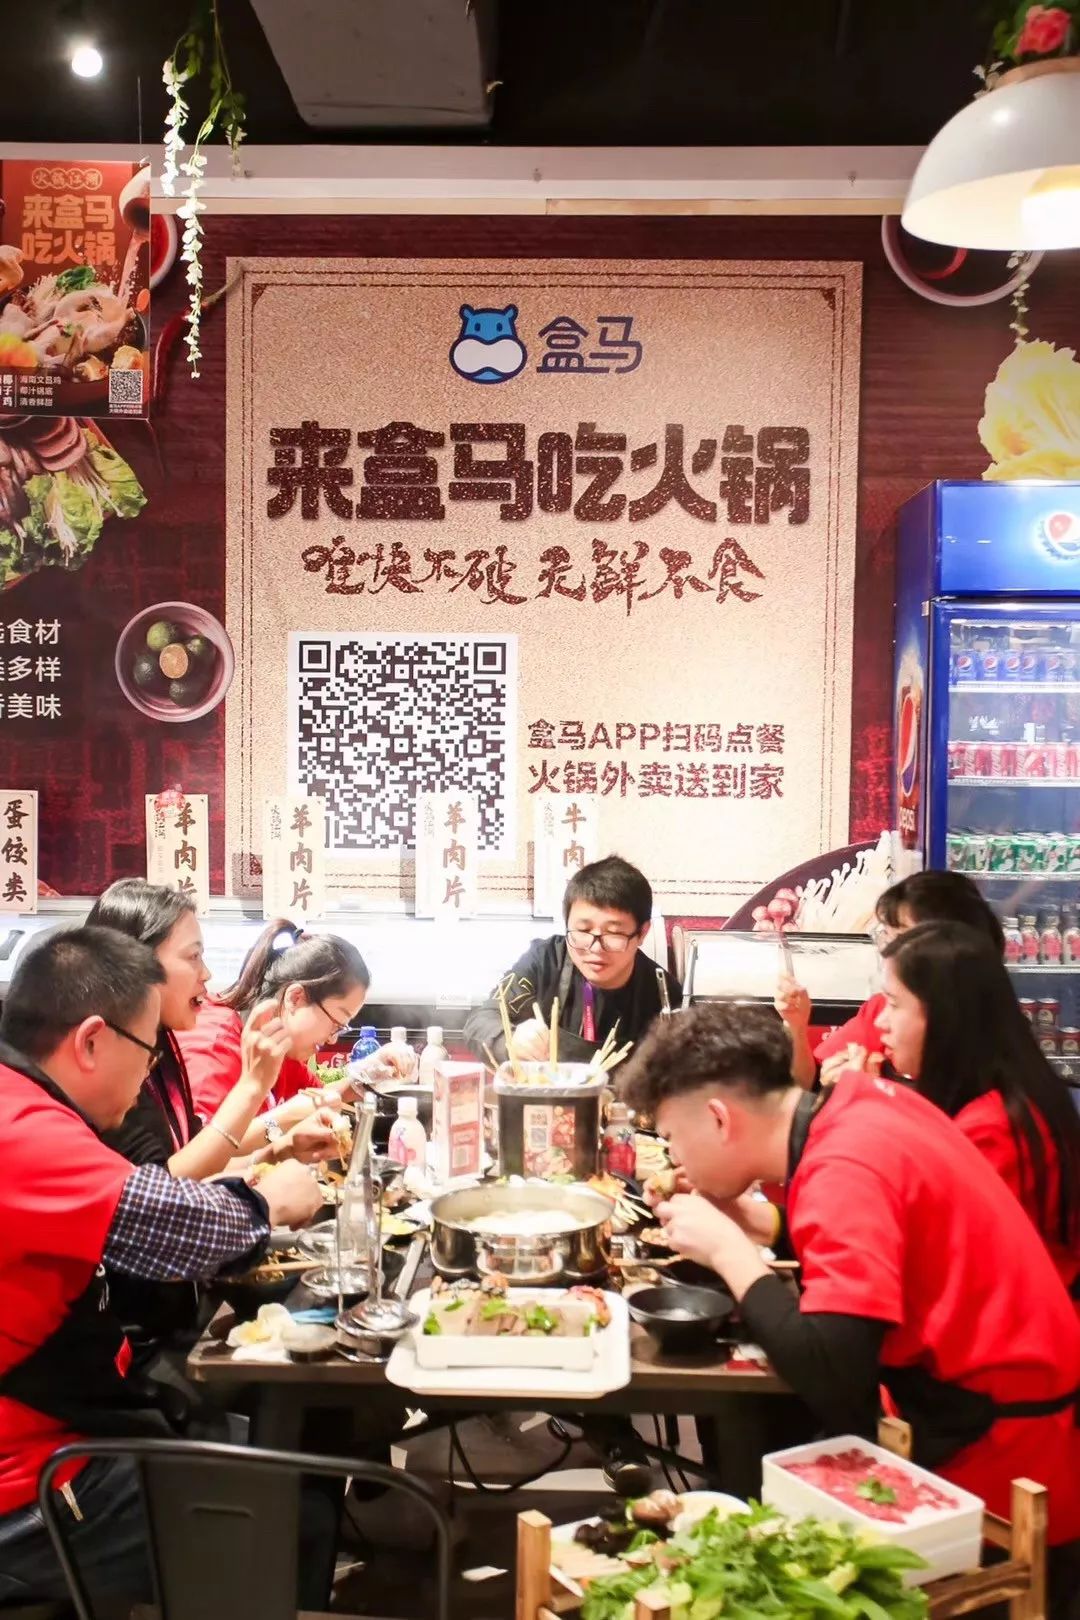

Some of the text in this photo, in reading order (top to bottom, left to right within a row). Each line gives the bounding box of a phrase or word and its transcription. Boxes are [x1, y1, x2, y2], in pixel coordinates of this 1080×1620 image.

[22, 194, 115, 230] 来盒马
[22, 230, 116, 266] 吃火锅
[537, 316, 643, 374] 盒马
[267, 420, 811, 525] 来盒马吃火锅
[301, 535, 528, 604] 唯快不破
[0, 618, 61, 645] 食材
[0, 655, 61, 682] 多样
[0, 692, 61, 720] 美味
[527, 718, 785, 754] 盒马APP扫码点餐
[527, 759, 785, 800] 火锅外卖送到家
[1, 799, 29, 902] 蛋饺类
[289, 803, 313, 912] 羊肉片
[442, 800, 467, 909] 羊肉片
